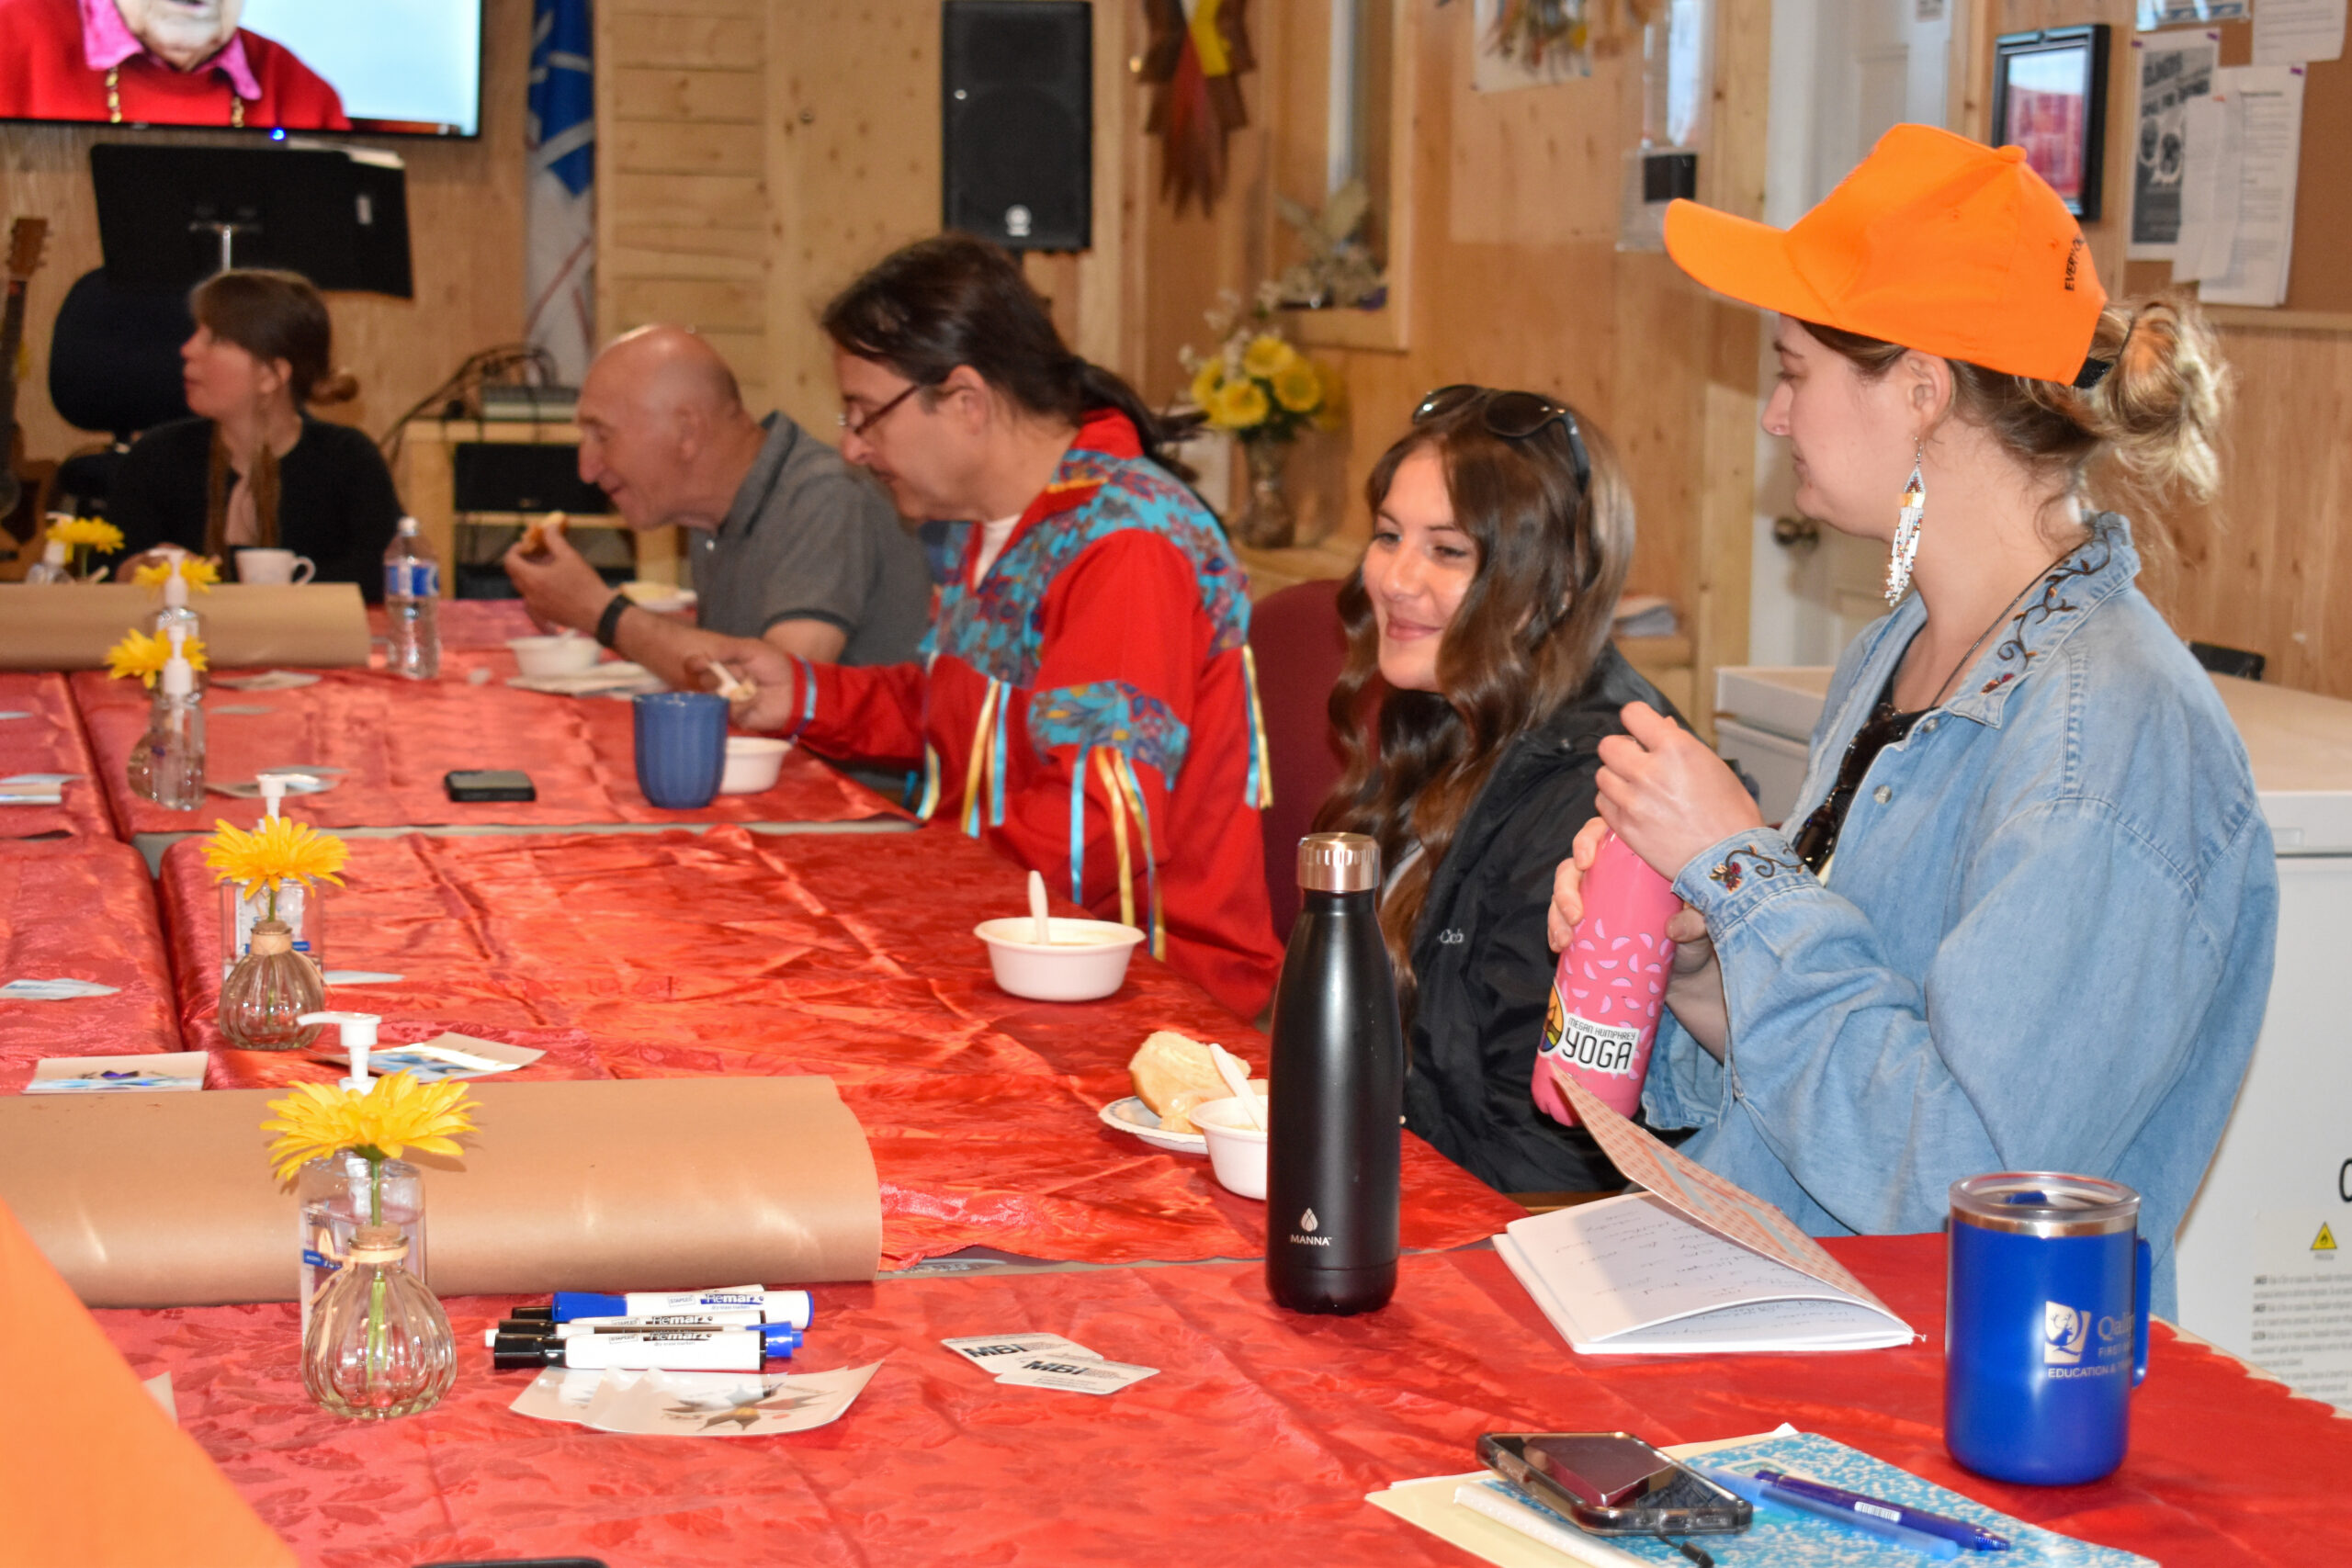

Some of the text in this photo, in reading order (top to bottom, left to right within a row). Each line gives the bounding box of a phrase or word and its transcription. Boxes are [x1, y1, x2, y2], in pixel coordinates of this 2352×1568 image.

[1568, 1017, 1635, 1040] MEGAN HUMPHREY
[1562, 1027, 1633, 1069] YOGA
[1290, 1235, 1329, 1246] MANNA
[963, 1343, 1028, 1358] MBI
[1022, 1360, 1089, 1375] MBI
[2048, 1365, 2109, 1379] EDUCATION
